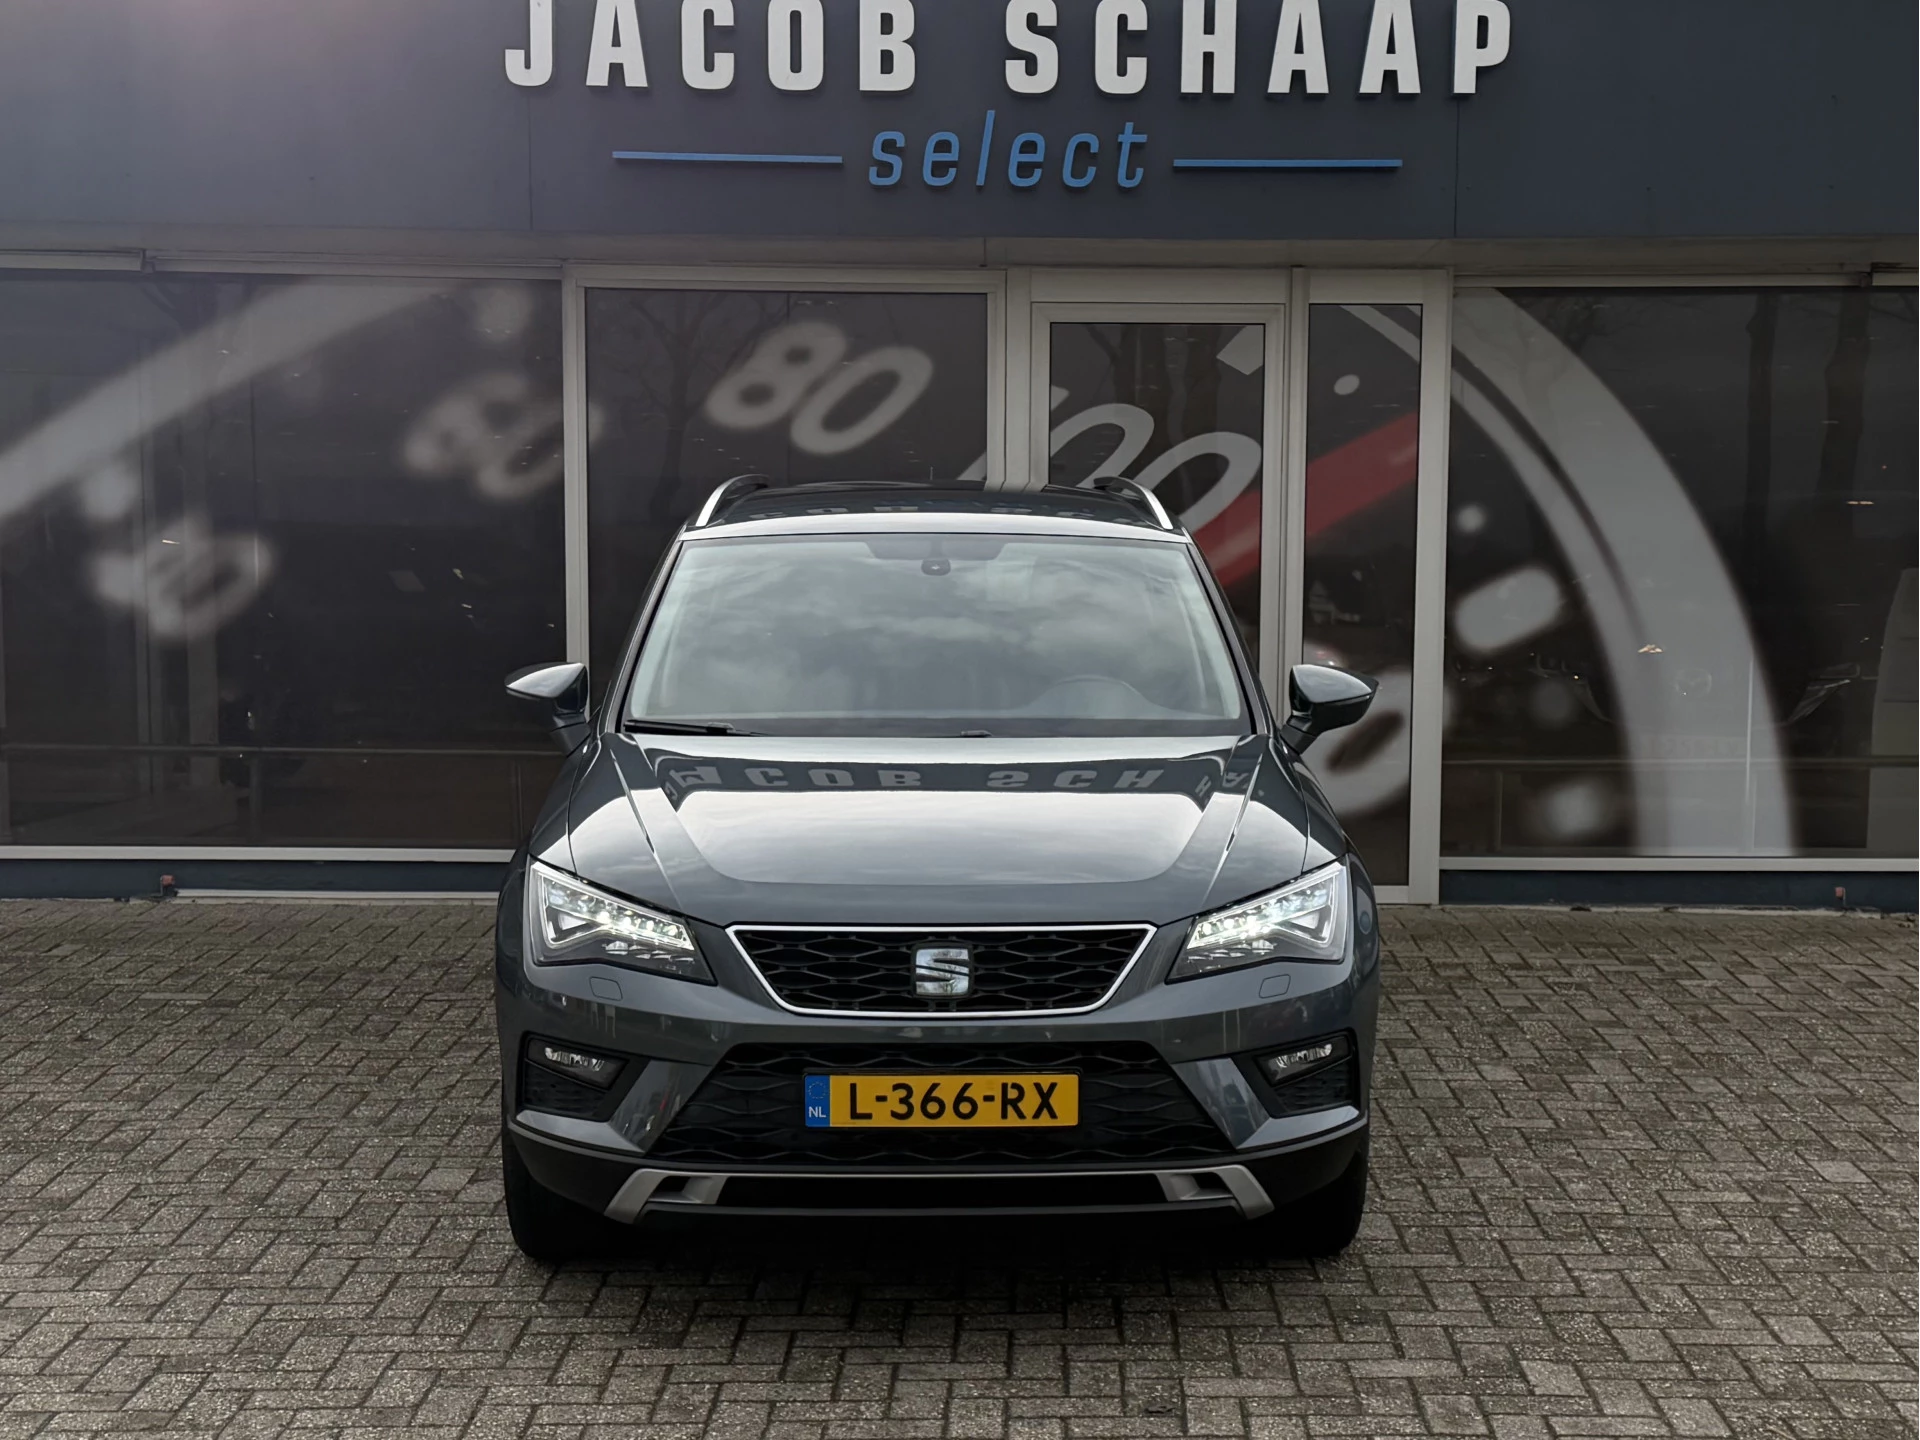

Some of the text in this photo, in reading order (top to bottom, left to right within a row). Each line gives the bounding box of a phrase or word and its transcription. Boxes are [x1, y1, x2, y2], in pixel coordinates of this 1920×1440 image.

[505, 0, 1511, 95] JACOB SCHAAP
[868, 110, 1148, 188] select
[704, 321, 934, 455] 80
[808, 1082, 1059, 1120] NL L-366-RX
